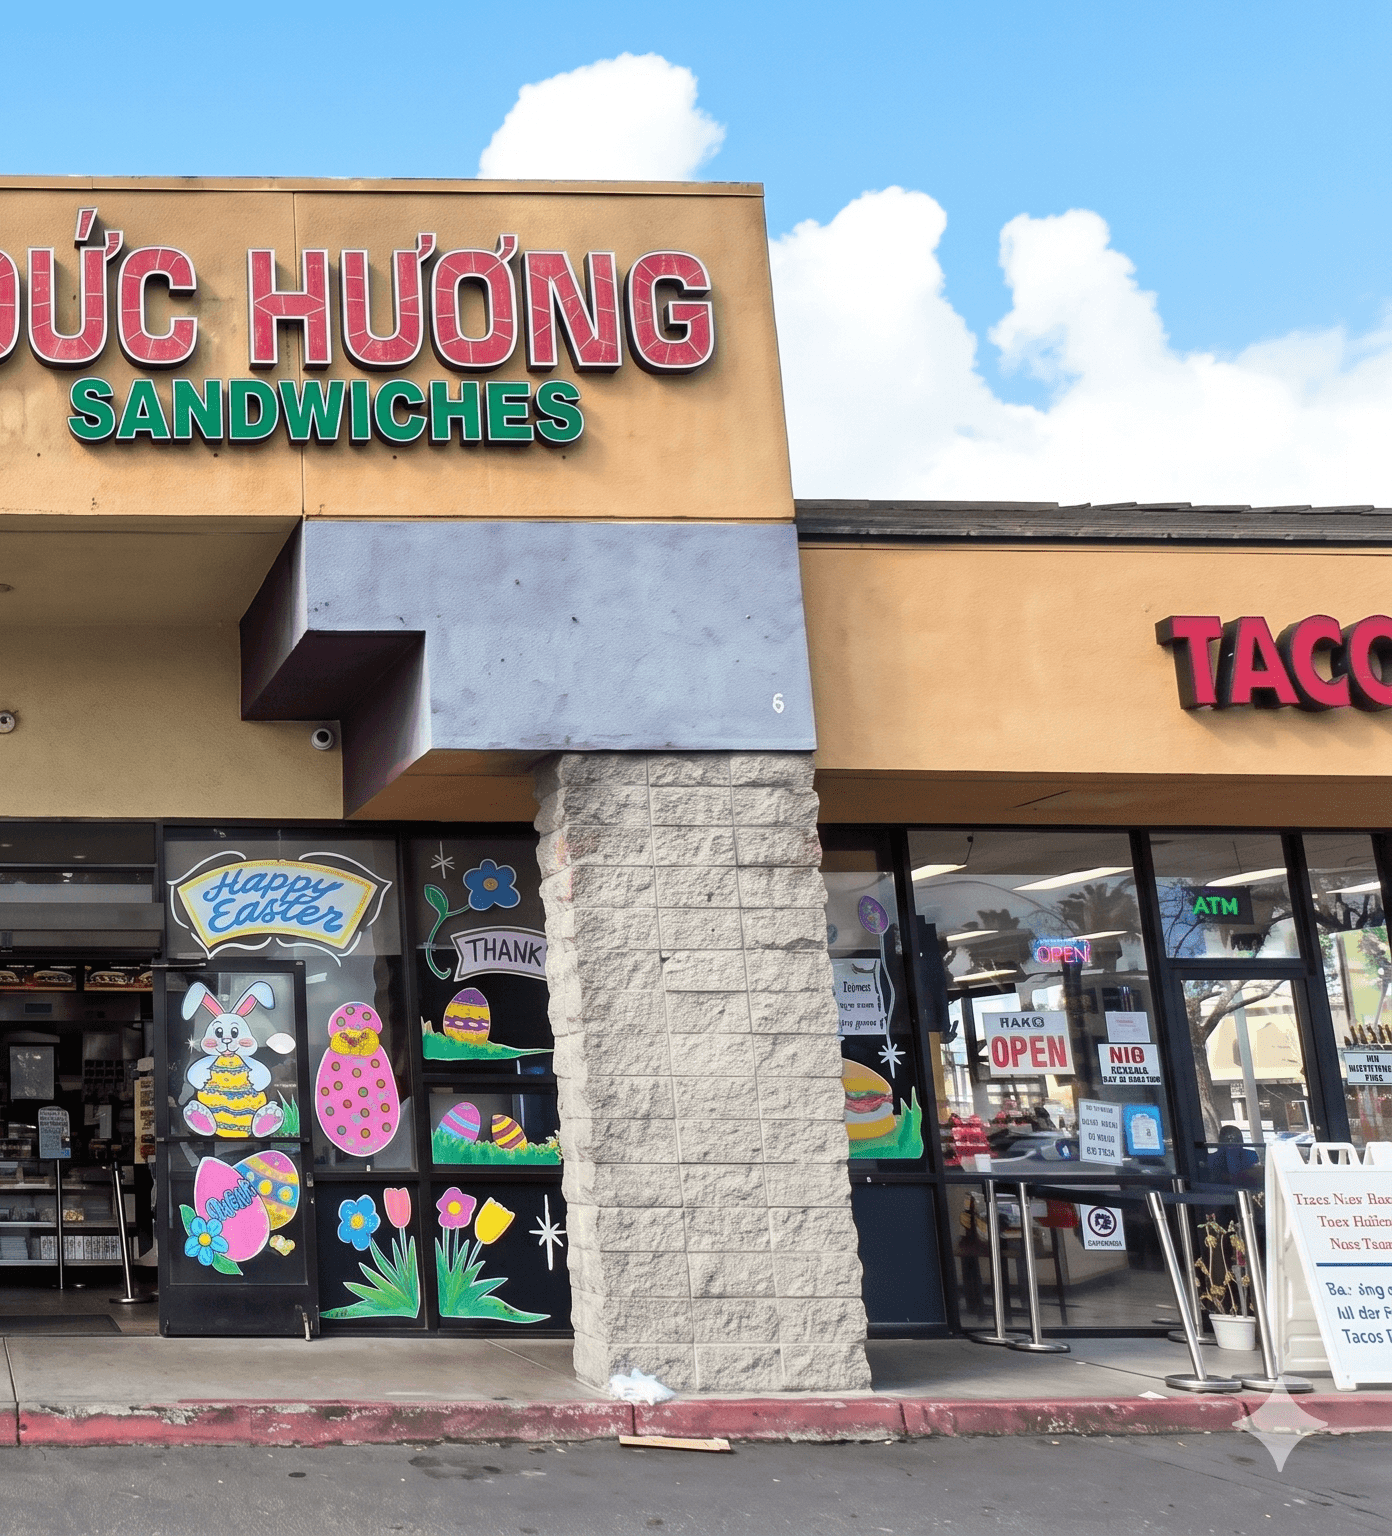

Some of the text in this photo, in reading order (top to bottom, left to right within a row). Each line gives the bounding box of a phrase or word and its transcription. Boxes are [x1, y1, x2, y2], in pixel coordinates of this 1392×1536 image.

[247, 232, 716, 370] HƯƠNG
[67, 377, 585, 444] SANDWICHES
[772, 692, 785, 714] 6
[202, 868, 345, 904] Happy
[208, 896, 344, 933] Easter
[1192, 895, 1239, 915] ATM
[464, 937, 543, 967] THANK
[1037, 946, 1088, 963] OPEN
[991, 1035, 1068, 1068] OPEN
[1341, 1328, 1384, 1344] Tacos
